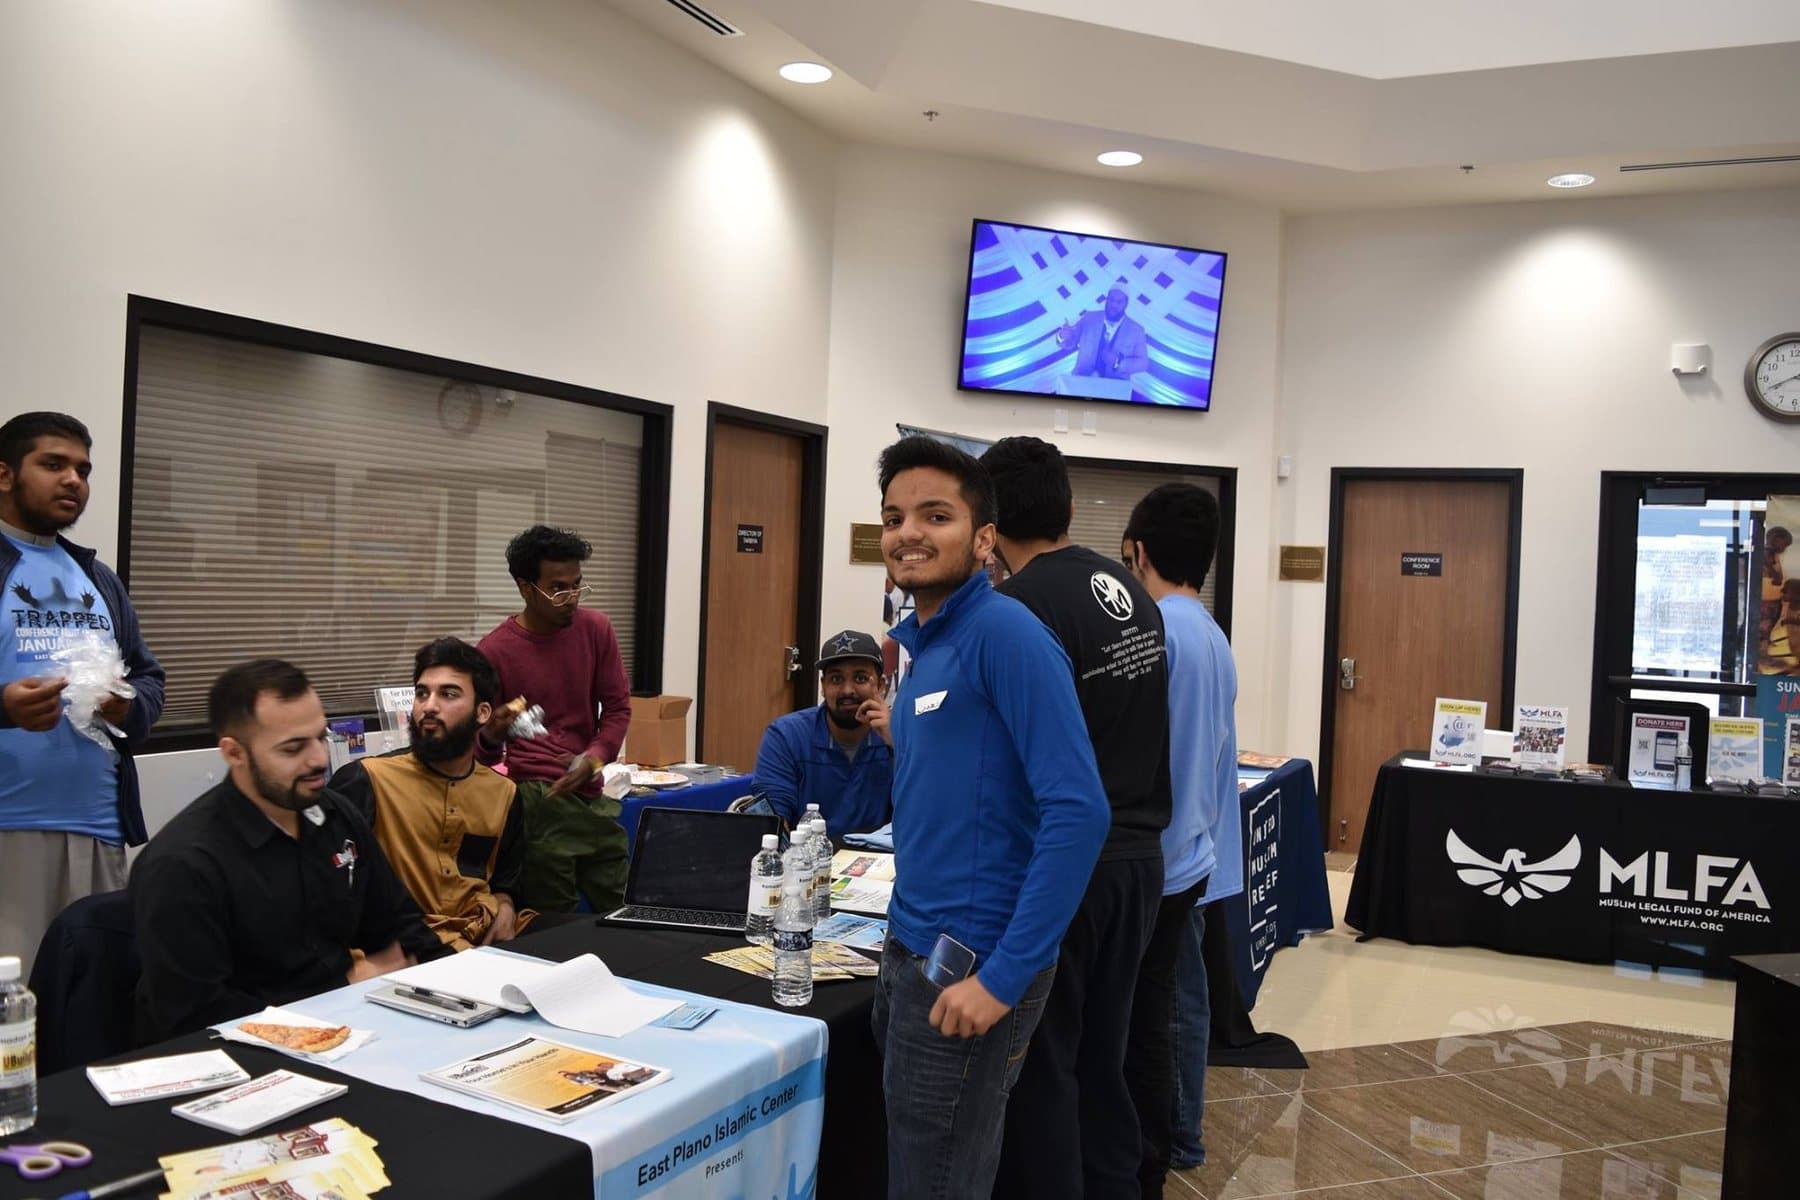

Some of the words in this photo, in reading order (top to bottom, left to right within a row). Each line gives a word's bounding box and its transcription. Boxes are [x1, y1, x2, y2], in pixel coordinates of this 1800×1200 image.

[1768, 363, 1778, 371] 10
[1763, 375, 1769, 383] 9
[11, 609, 111, 631] TRAPPED
[17, 638, 74, 652] JANUA
[1540, 710, 1562, 718] MLFA
[1638, 718, 1665, 726] DONATE
[1600, 847, 1772, 910] MLFA
[1599, 898, 1636, 910] MUSLIM
[1639, 902, 1671, 913] LEGAL
[1674, 906, 1702, 916] FUND
[1704, 908, 1720, 918] OF
[1721, 911, 1771, 923] AMERICA
[1640, 915, 1724, 932] WWW.MLFA.ORG
[637, 1154, 670, 1187] East
[672, 1132, 711, 1167] Plano
[715, 1105, 757, 1143] Islamic
[761, 1084, 798, 1116] Center
